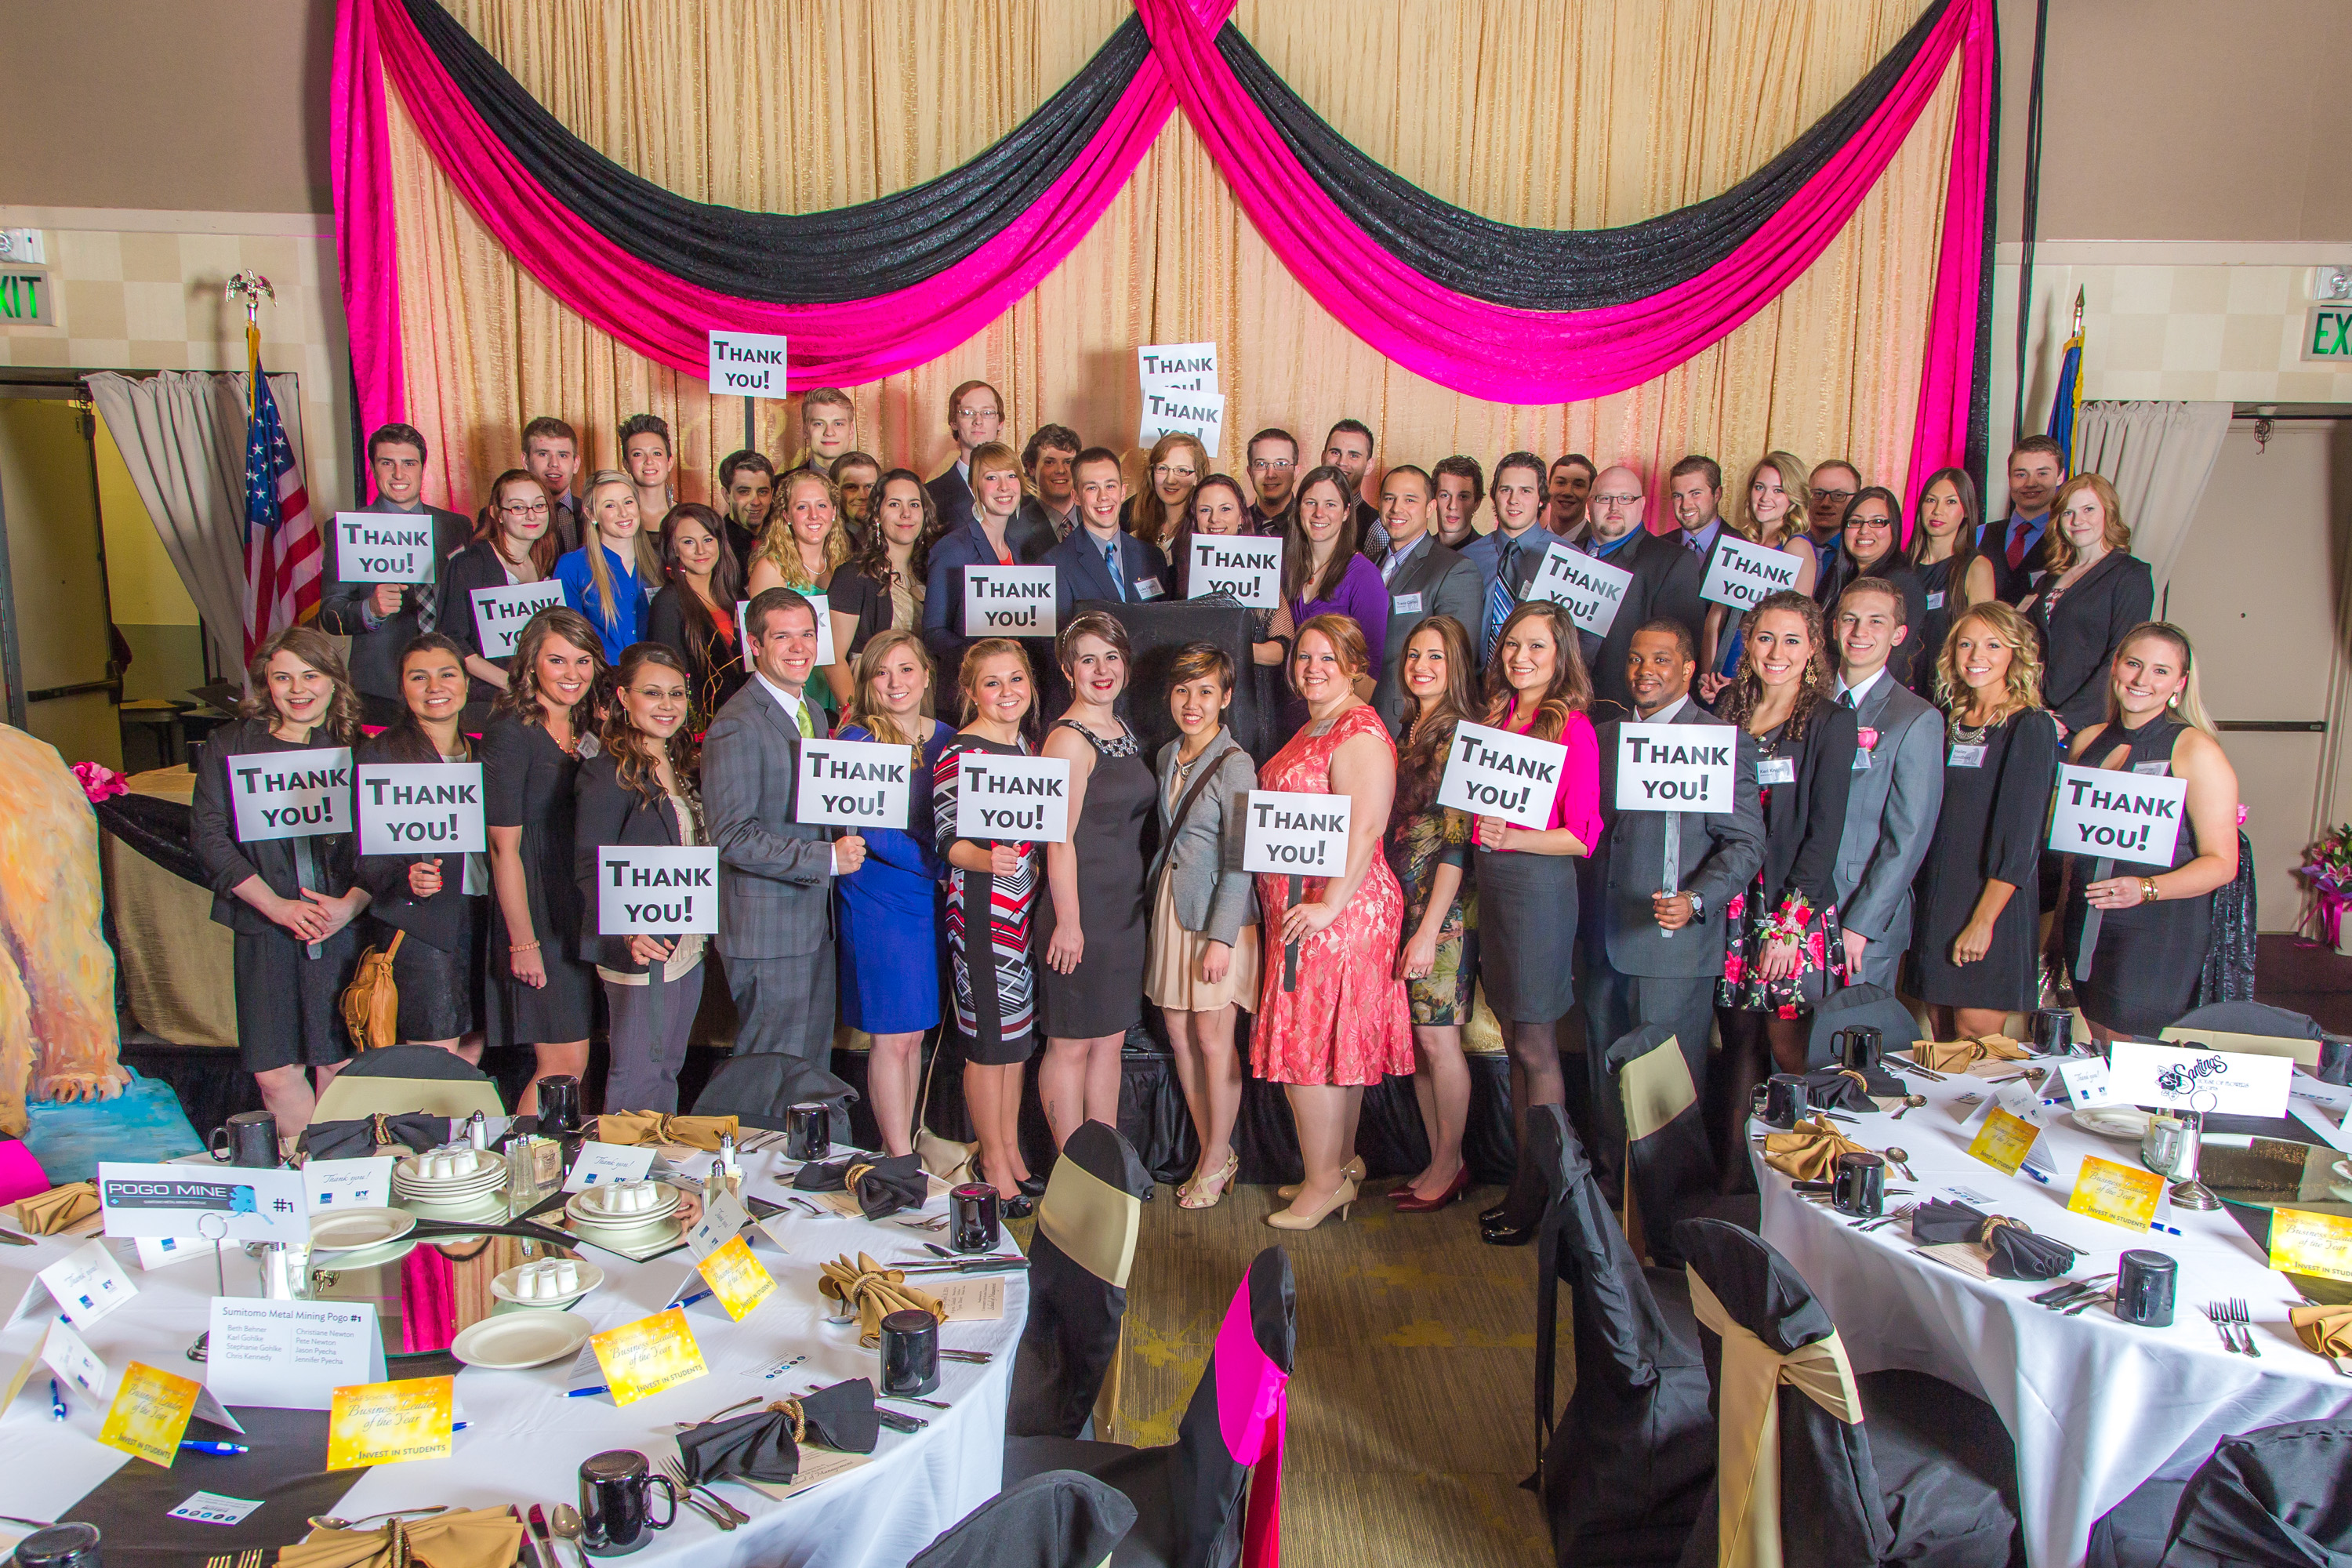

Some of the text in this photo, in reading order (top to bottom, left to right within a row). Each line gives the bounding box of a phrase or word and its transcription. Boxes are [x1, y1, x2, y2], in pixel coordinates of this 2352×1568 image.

[0, 275, 42, 318] XIT
[2312, 312, 2352, 354] EX
[713, 341, 782, 365] THANK
[1143, 355, 1213, 374] THANK
[725, 371, 769, 388] YOU!
[1149, 395, 1219, 423] THANK
[344, 524, 427, 546] THANK
[358, 553, 415, 574] YOU!
[1196, 545, 1276, 570] THANK
[1721, 546, 1793, 586] THANK
[971, 577, 1051, 597] THANK
[1549, 554, 1622, 601] THANK
[985, 605, 1036, 626] YOU!
[1460, 735, 1556, 783] THANK
[1626, 737, 1729, 765] THANK
[807, 752, 904, 782] THANK
[237, 768, 349, 793] THANK
[365, 779, 477, 805] THANK
[965, 767, 1062, 797] THANK
[1642, 775, 1708, 800] YOU!
[822, 791, 885, 816] YOU!
[1466, 781, 1530, 813] YOU!
[2067, 779, 2176, 818] THANK
[261, 797, 333, 827] YOU!
[980, 805, 1044, 829] YOU!
[1254, 804, 1345, 832] THANK
[387, 814, 458, 841] YOU!
[2078, 825, 2150, 851] YOU!
[1266, 840, 1325, 865] YOU!
[606, 861, 712, 887] THANK
[624, 896, 692, 923] YOU!
[594, 1156, 635, 1170] Thank you!
[109, 1184, 227, 1197] POGO MINE
[323, 1171, 372, 1185] Thank you!
[2089, 1171, 2151, 1196] Business Leader
[2096, 1185, 2105, 1195] of
[2105, 1185, 2114, 1196] the
[273, 1198, 294, 1213] #1
[2088, 1205, 2107, 1217] INVEST
[2116, 1215, 2147, 1229] STUDENTS
[2286, 1224, 2327, 1238] Business
[2328, 1231, 2352, 1243] Lea
[2298, 1238, 2348, 1251] of the Year
[2295, 1261, 2320, 1271] INVEST
[2332, 1269, 2352, 1277] STUD
[740, 1296, 753, 1309] INVEST
[757, 1280, 774, 1296] STUDENTS
[223, 1306, 361, 1323] Sumitomo Metal Mining Pogo #1
[296, 1328, 328, 1337] Christiane
[610, 1327, 680, 1359] Business Leader
[226, 1343, 282, 1352] Stephanie Gohlke
[245, 1353, 272, 1362] Kennedy
[629, 1345, 672, 1370] of the Year
[637, 1380, 660, 1393] INVEST
[671, 1364, 703, 1381] STUDENTS
[347, 1396, 438, 1417] Business Leader
[362, 1412, 421, 1432] of the Year
[118, 1432, 172, 1460] INVEST IN STUDENTS
[358, 1450, 389, 1460] INVEST
[403, 1444, 446, 1455] STUDENTS
